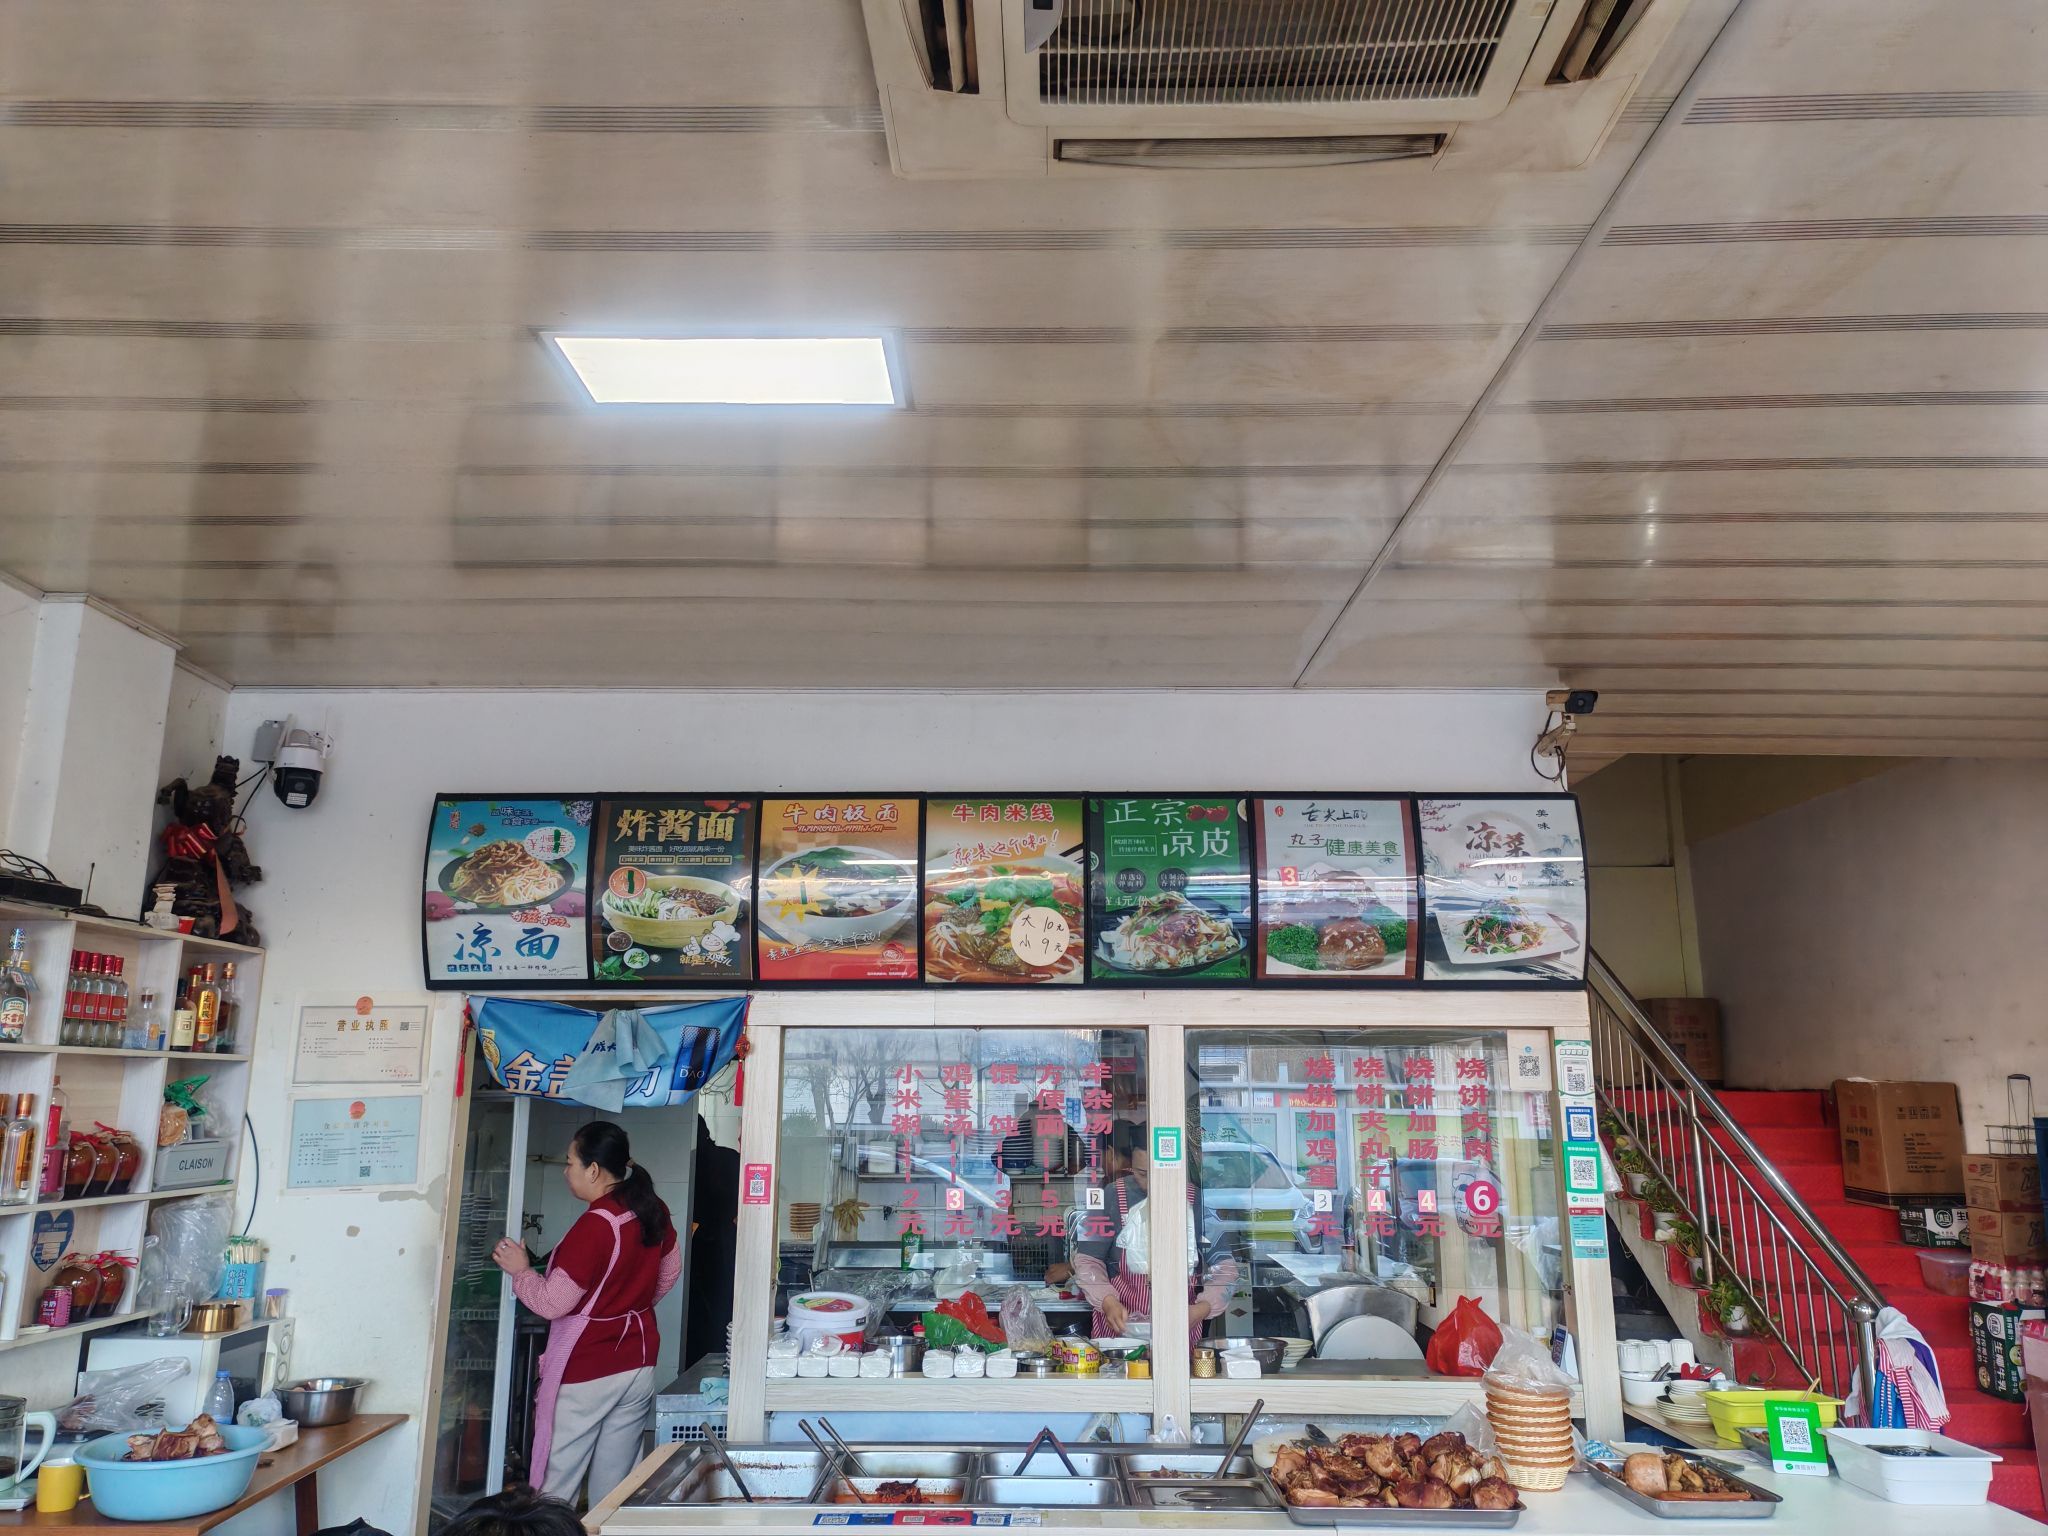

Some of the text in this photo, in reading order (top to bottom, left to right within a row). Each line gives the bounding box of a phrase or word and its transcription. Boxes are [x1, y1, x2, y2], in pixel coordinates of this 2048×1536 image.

[783, 803, 899, 824] 牛肉板面
[952, 802, 1054, 822] 牛肉米线
[1106, 799, 1186, 826] 正宗
[1302, 802, 1368, 822] 舌尖上的
[615, 808, 735, 842] 炸酱面
[1160, 828, 1232, 857] 凉皮
[1291, 833, 1398, 856] 丸子 健康美食
[1466, 822, 1530, 857] 凉菜
[1022, 915, 1036, 928] 大
[453, 922, 560, 963] 凉面
[337, 1019, 389, 1031] 营业执照
[178, 1157, 214, 1171] CLAISON
